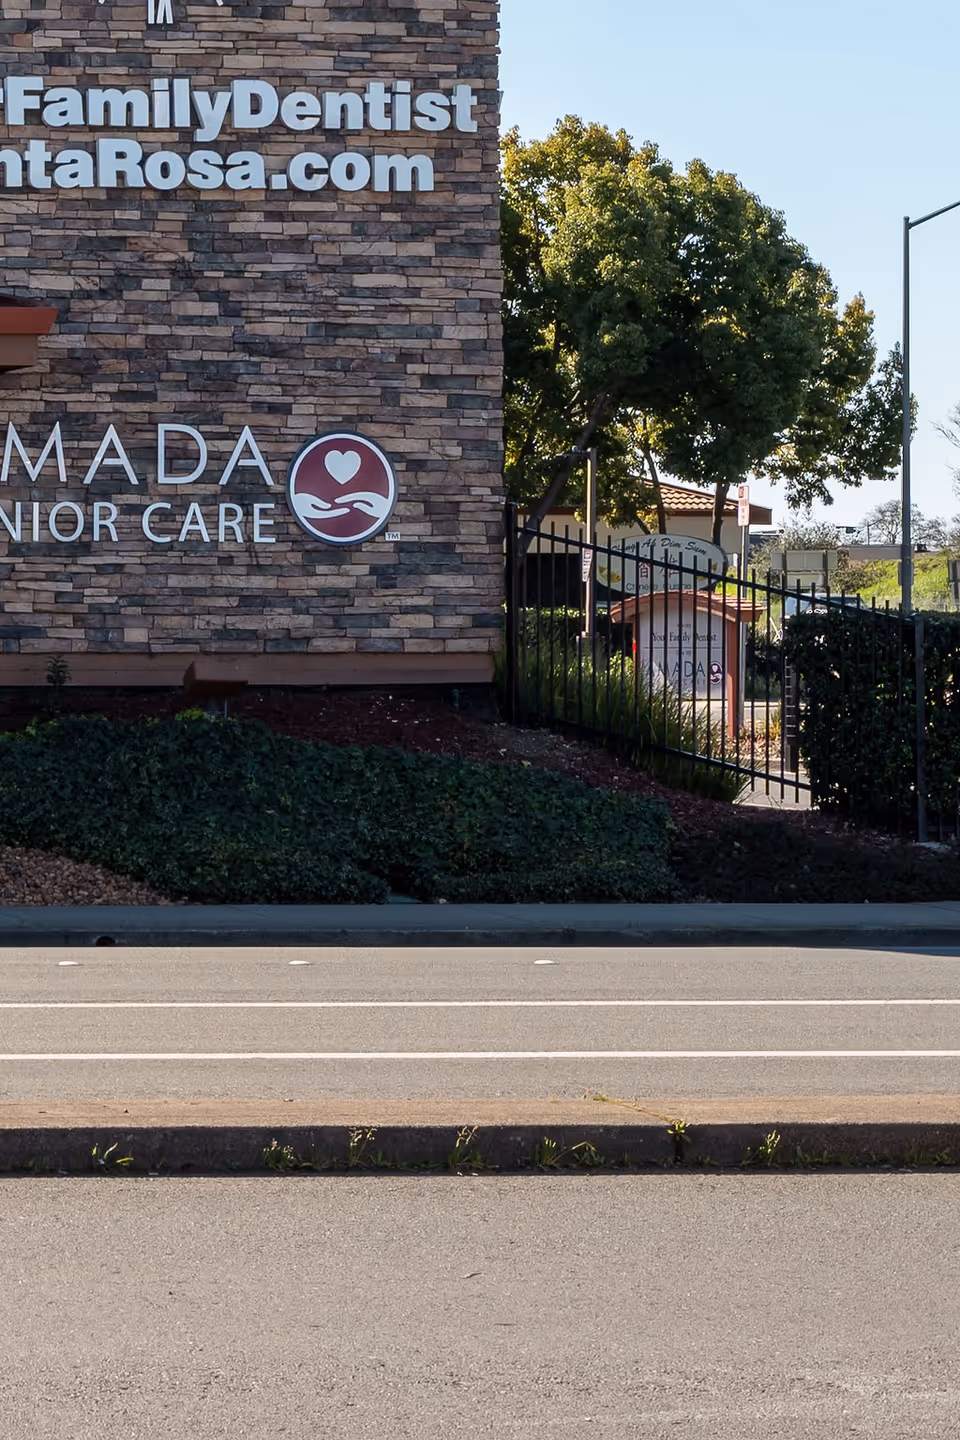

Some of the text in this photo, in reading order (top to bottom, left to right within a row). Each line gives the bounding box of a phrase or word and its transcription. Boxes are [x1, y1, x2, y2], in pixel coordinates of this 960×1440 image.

[141, 501, 277, 544] CARE
[661, 537, 681, 548] Dim
[685, 541, 708, 555] Sum
[651, 632, 666, 641] You
[669, 632, 690, 643] Faily
[645, 661, 706, 677] MADA
